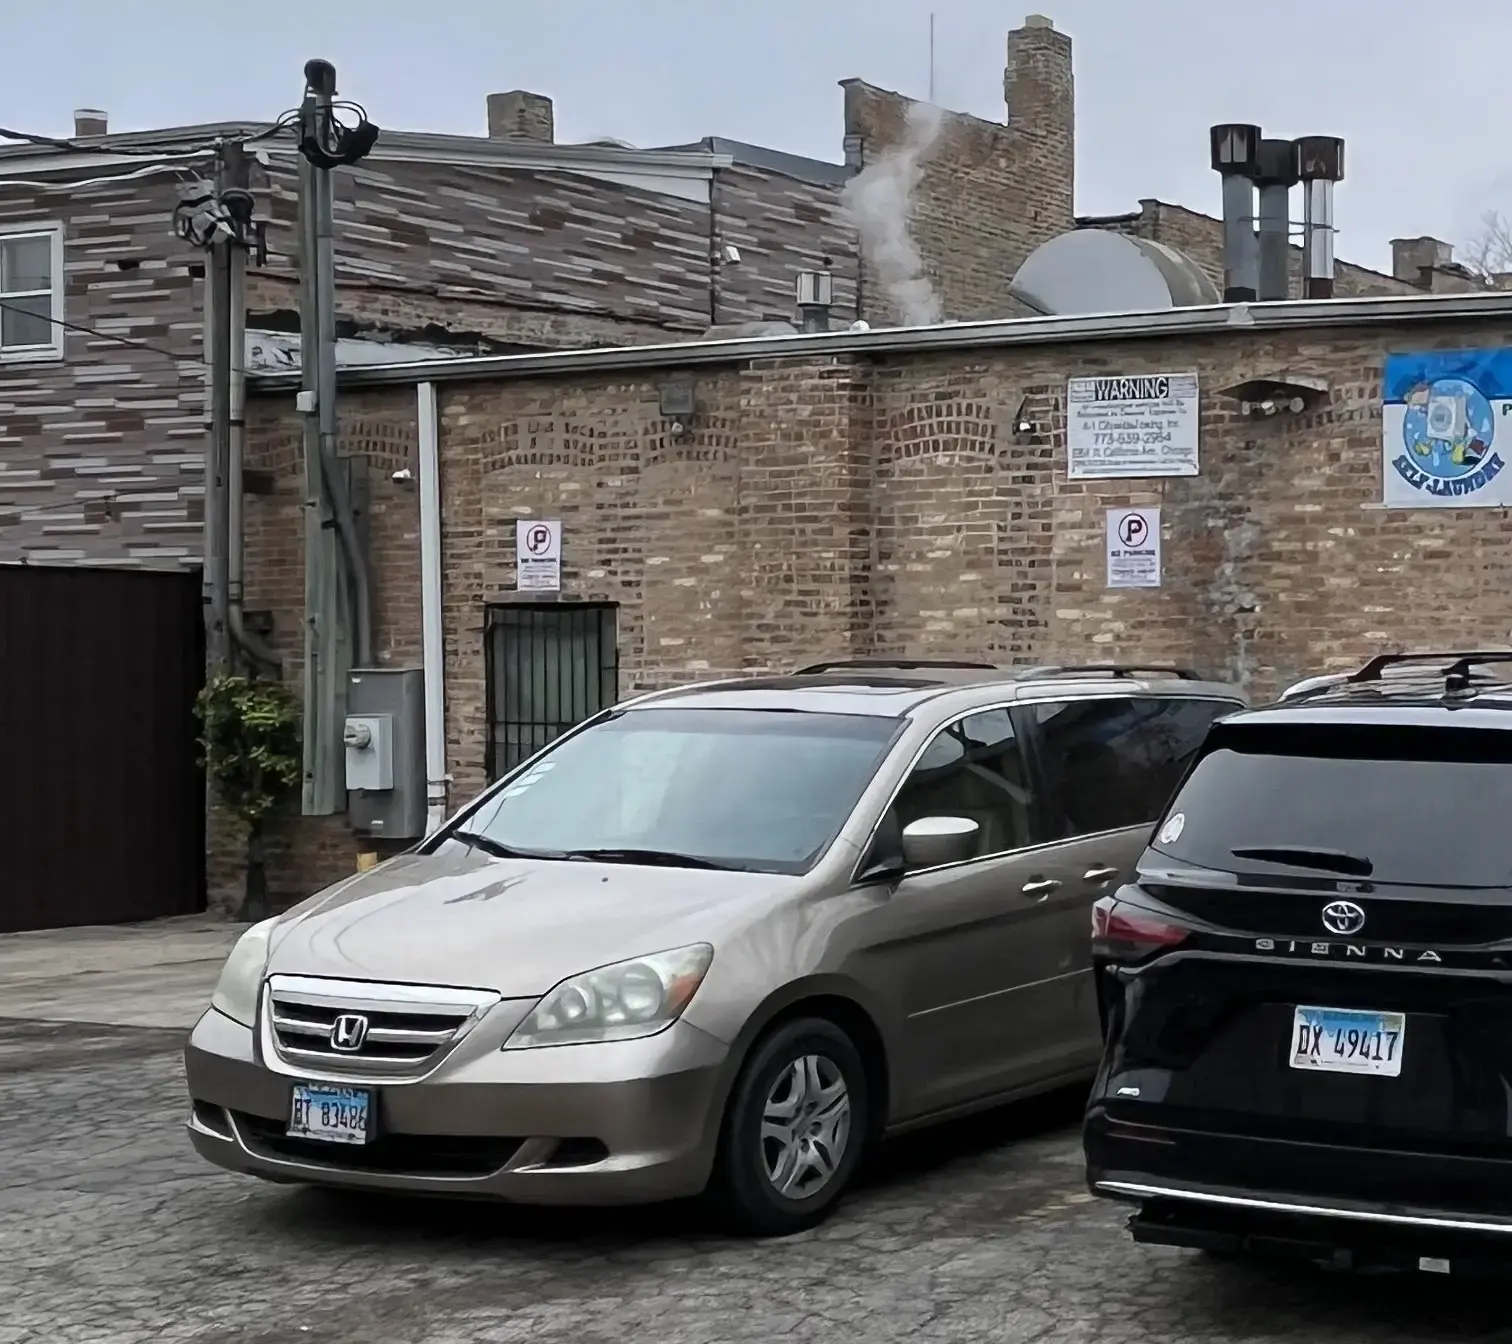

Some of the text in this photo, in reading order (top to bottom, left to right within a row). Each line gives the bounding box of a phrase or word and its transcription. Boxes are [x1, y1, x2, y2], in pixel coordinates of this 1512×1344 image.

[1096, 377, 1168, 400] WARNING
[1255, 938, 1442, 962] SIENNA
[1297, 1024, 1399, 1061] DX 49417
